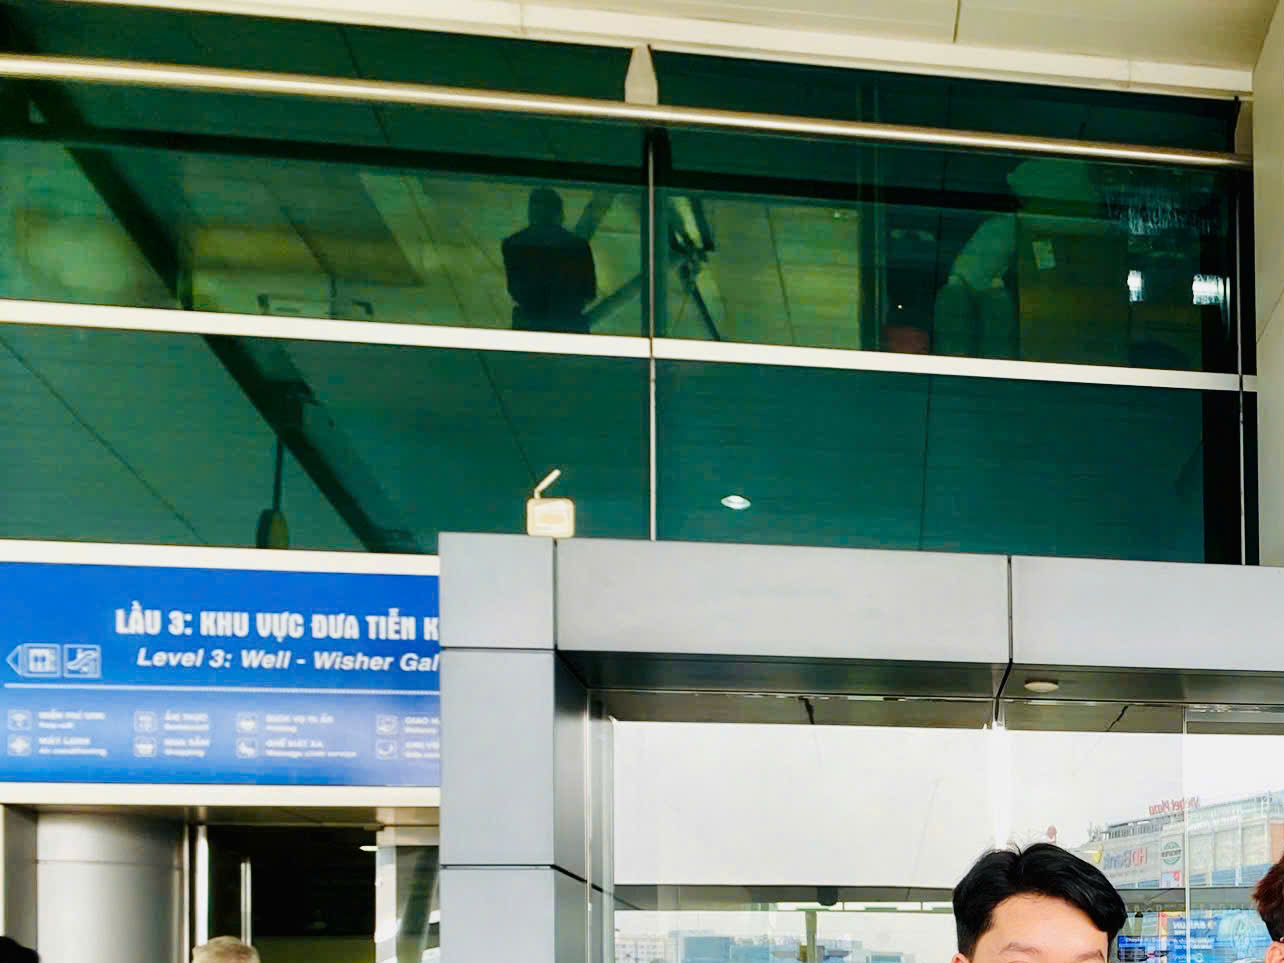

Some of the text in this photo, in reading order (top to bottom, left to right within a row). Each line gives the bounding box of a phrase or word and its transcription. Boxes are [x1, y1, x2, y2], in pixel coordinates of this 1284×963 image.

[115, 600, 415, 642] LẦU 3: KHU VỰC ĐƯA TIỄN
[136, 648, 204, 667] Level
[209, 649, 232, 668] 3:
[241, 650, 291, 670] Well
[313, 651, 393, 671] Wisher
